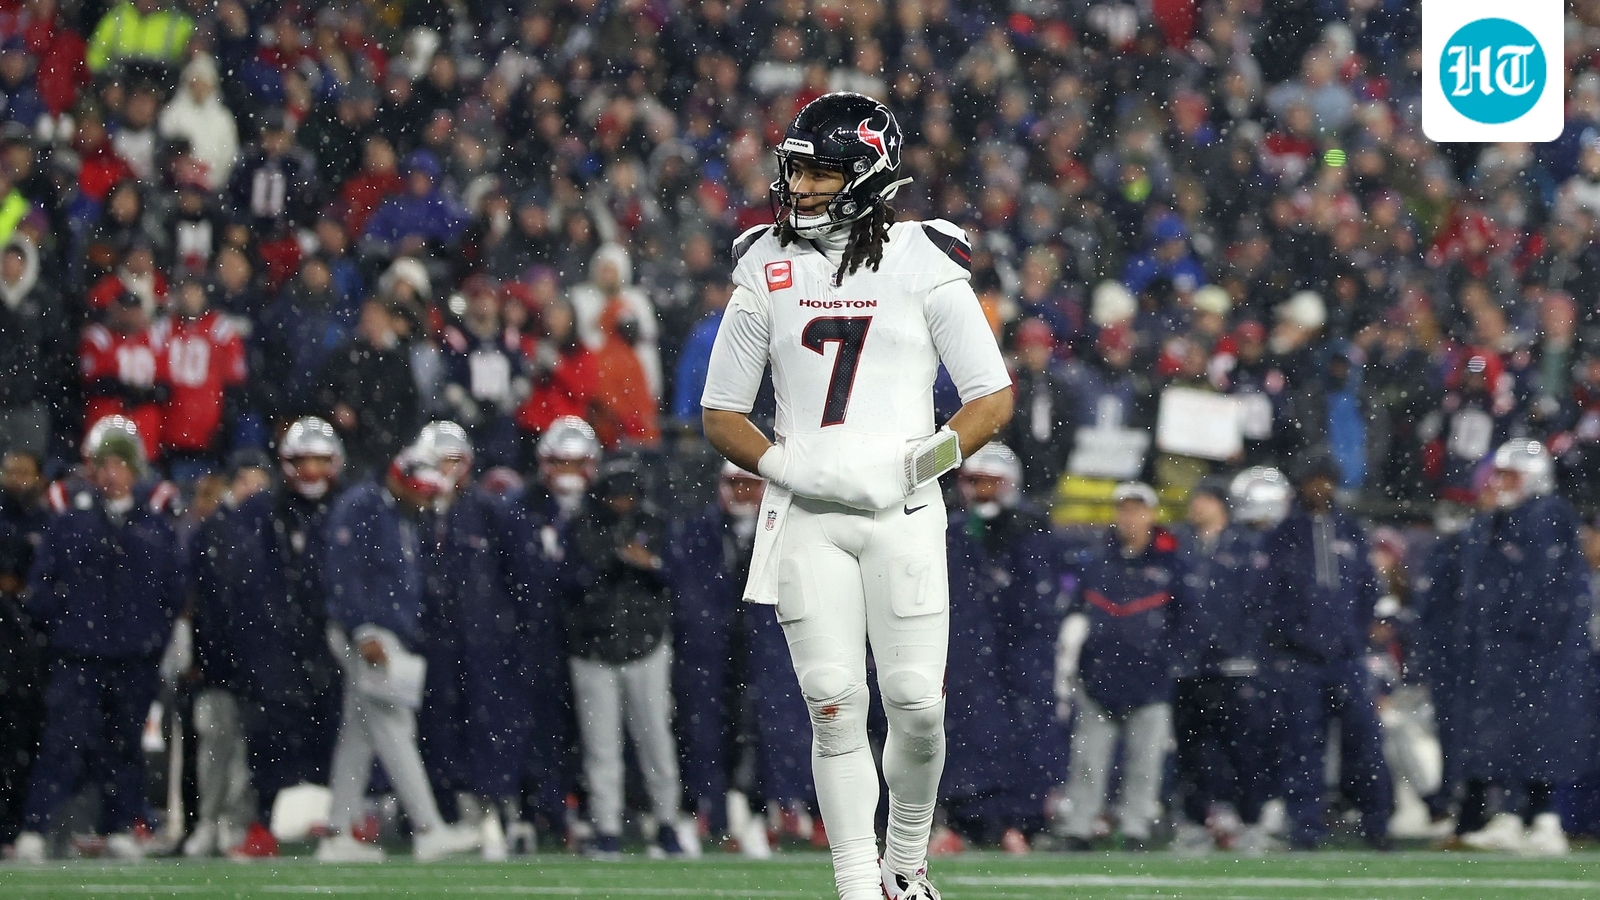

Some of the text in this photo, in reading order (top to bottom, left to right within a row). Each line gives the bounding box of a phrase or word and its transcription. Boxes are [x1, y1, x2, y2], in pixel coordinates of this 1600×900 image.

[767, 262, 790, 284] C
[799, 299, 878, 309] HOUSTON
[801, 315, 873, 428] 7
